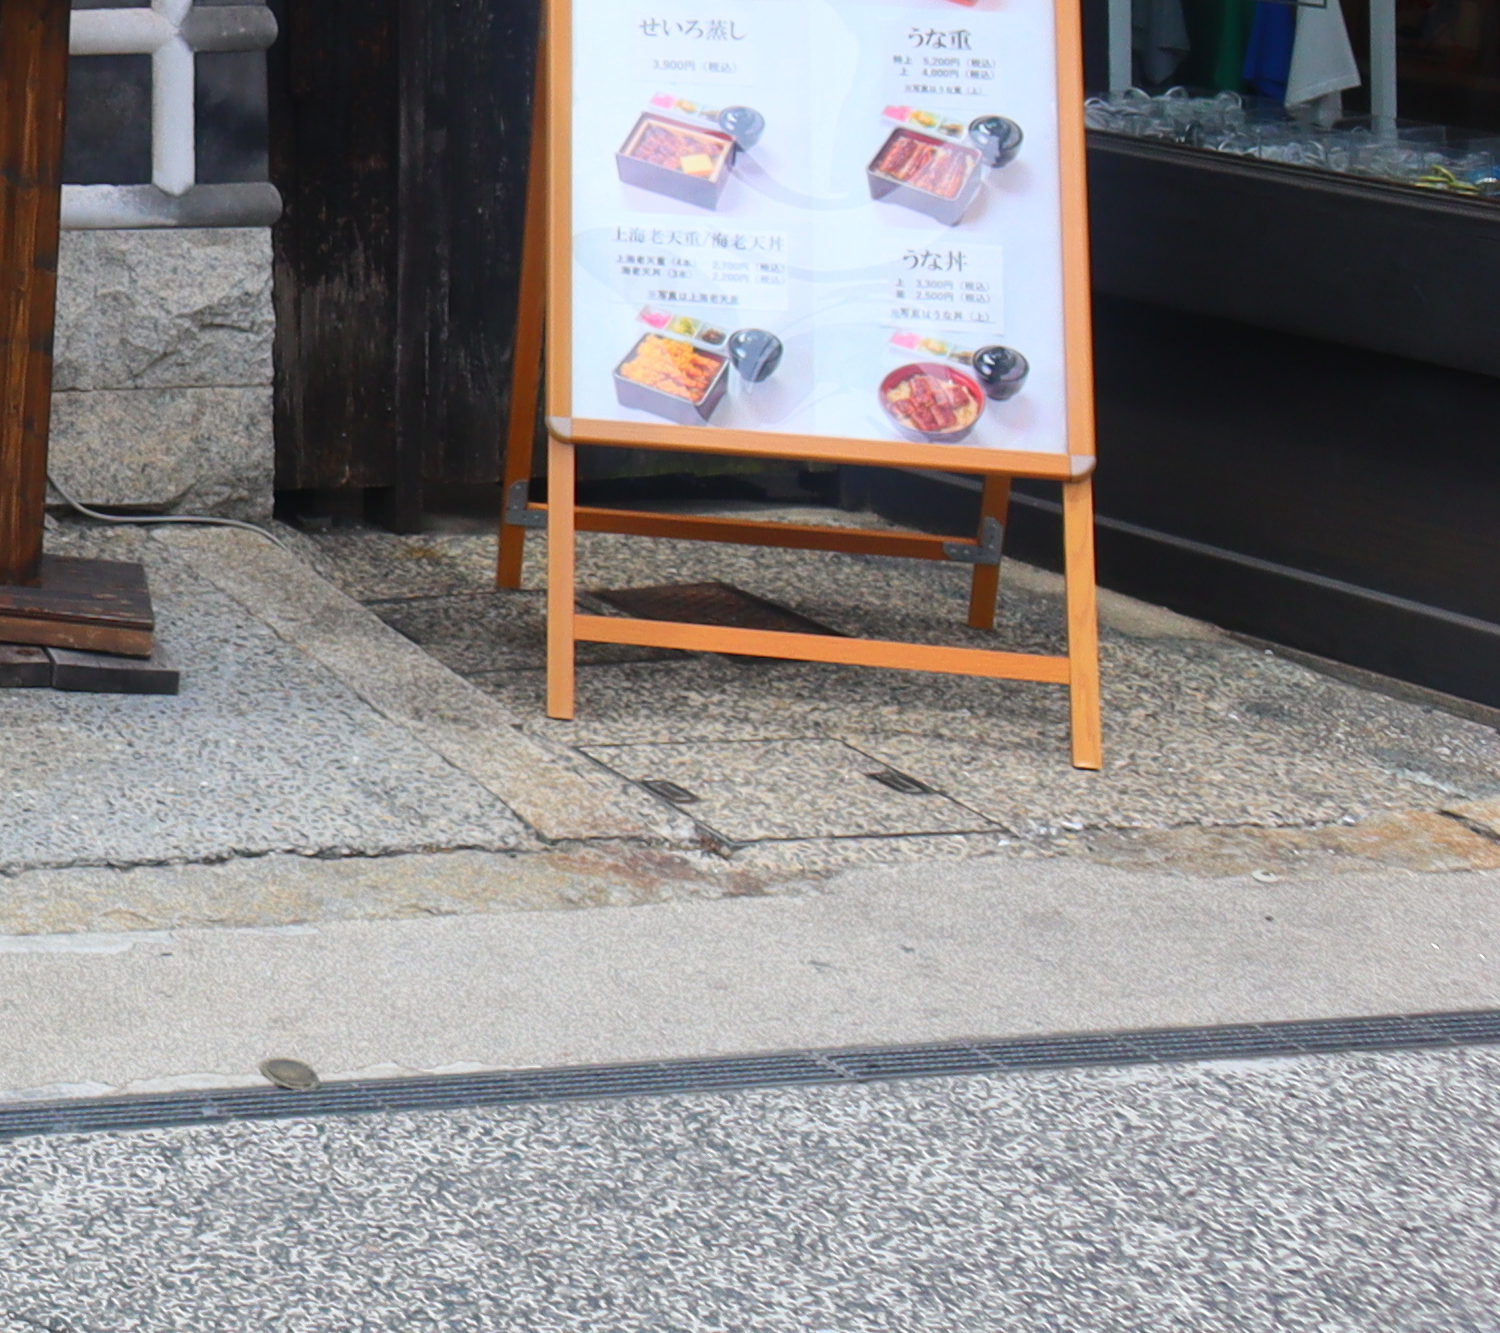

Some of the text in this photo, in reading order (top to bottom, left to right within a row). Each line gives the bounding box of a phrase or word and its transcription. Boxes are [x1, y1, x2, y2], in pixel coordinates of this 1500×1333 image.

[639, 17, 747, 41] せいろ蒸し
[908, 27, 972, 50] うな重
[902, 249, 968, 272] うな丼
